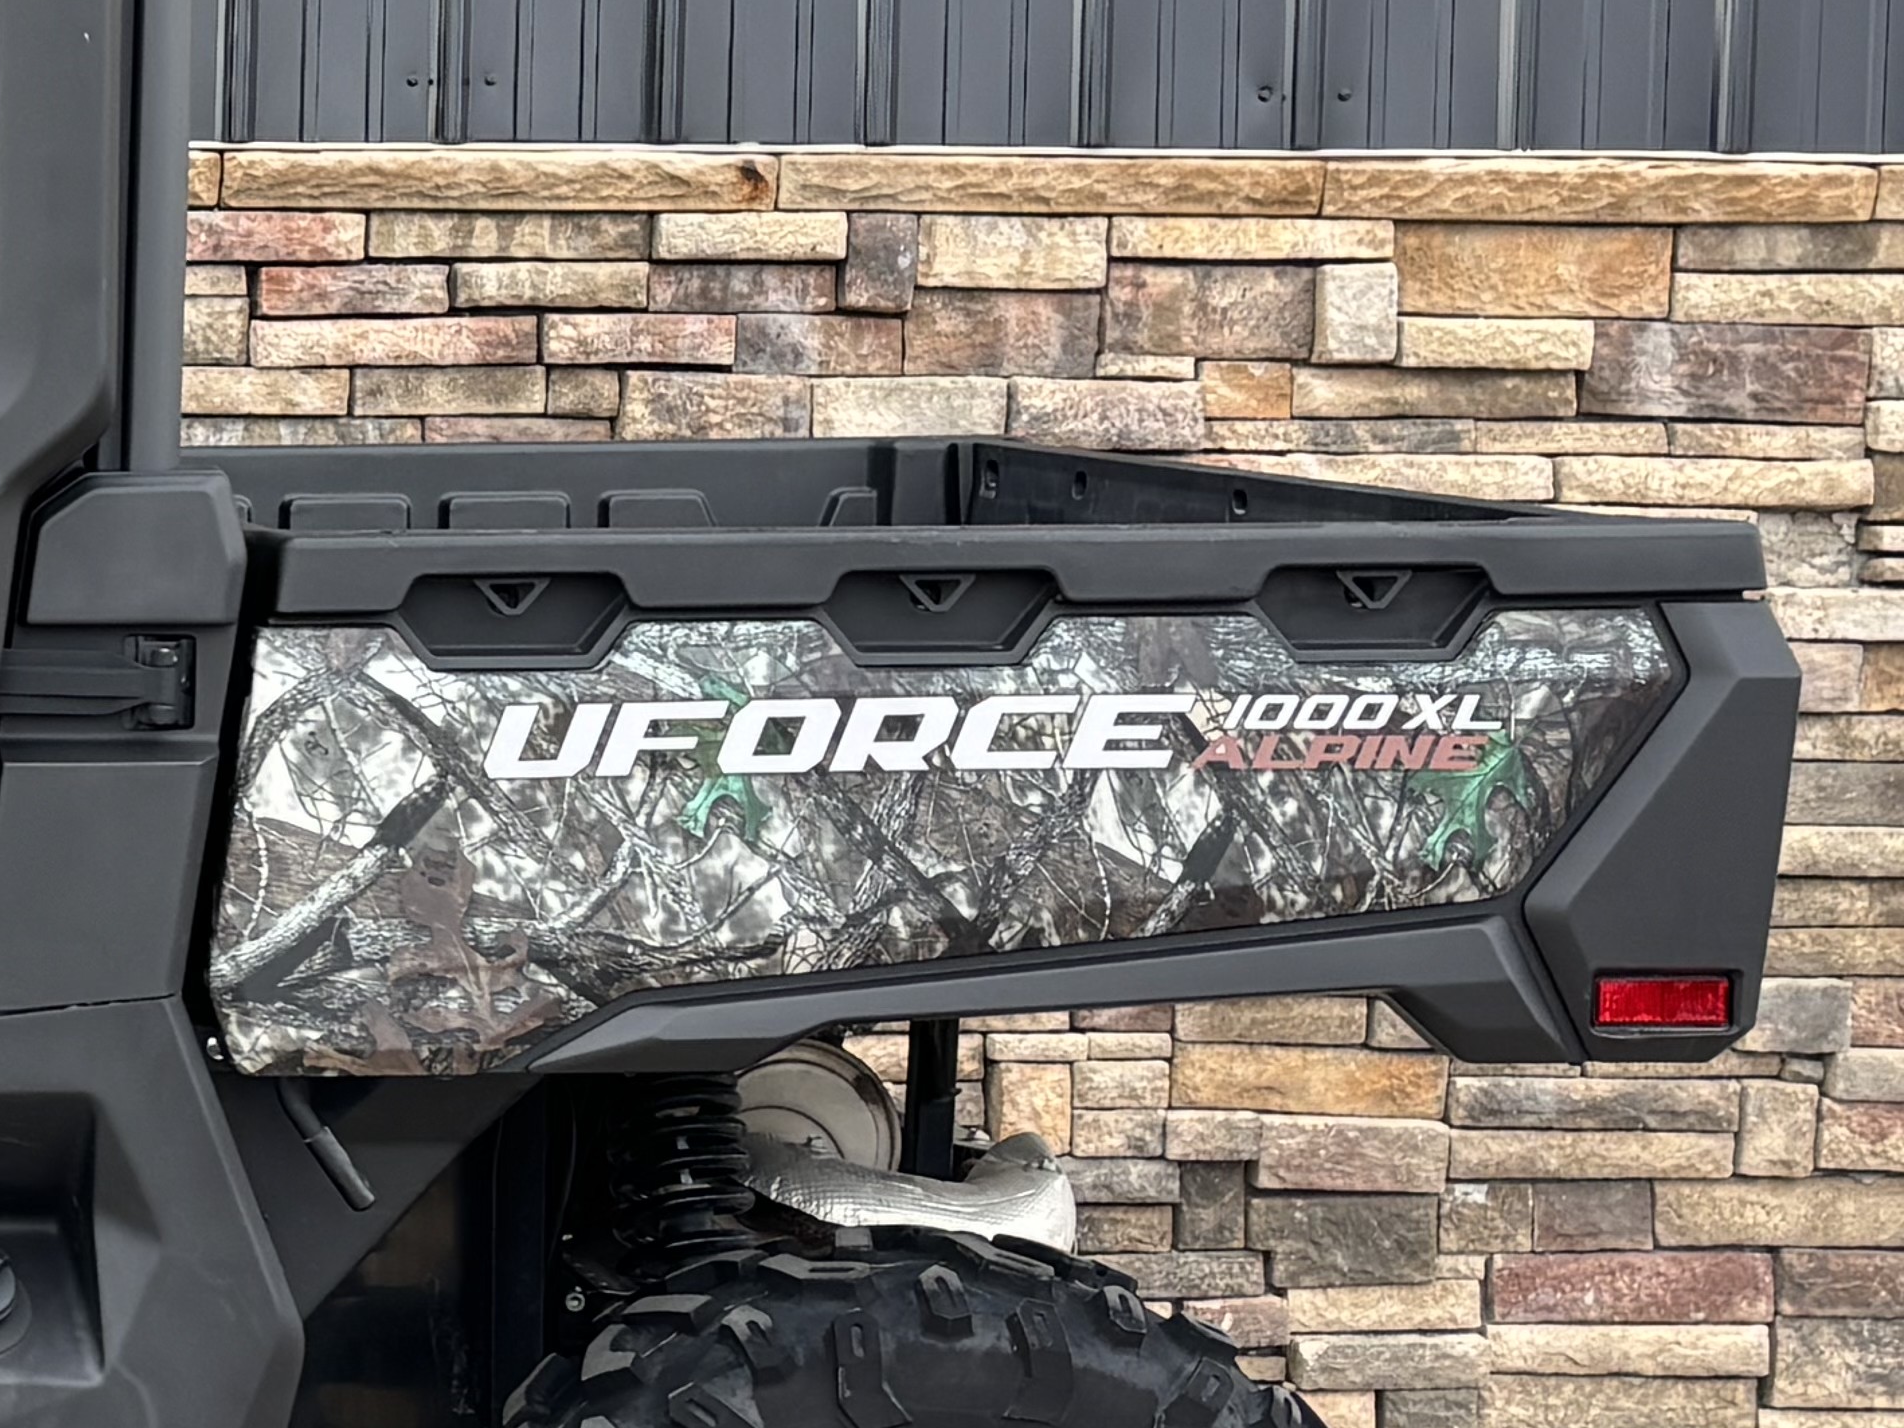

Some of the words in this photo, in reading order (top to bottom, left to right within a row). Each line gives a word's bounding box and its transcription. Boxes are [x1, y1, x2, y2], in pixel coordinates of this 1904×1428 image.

[1222, 693, 1400, 730] 1000
[1401, 693, 1504, 731] XL
[482, 693, 1193, 779] UFORCE
[1191, 734, 1491, 770] ALPINE
